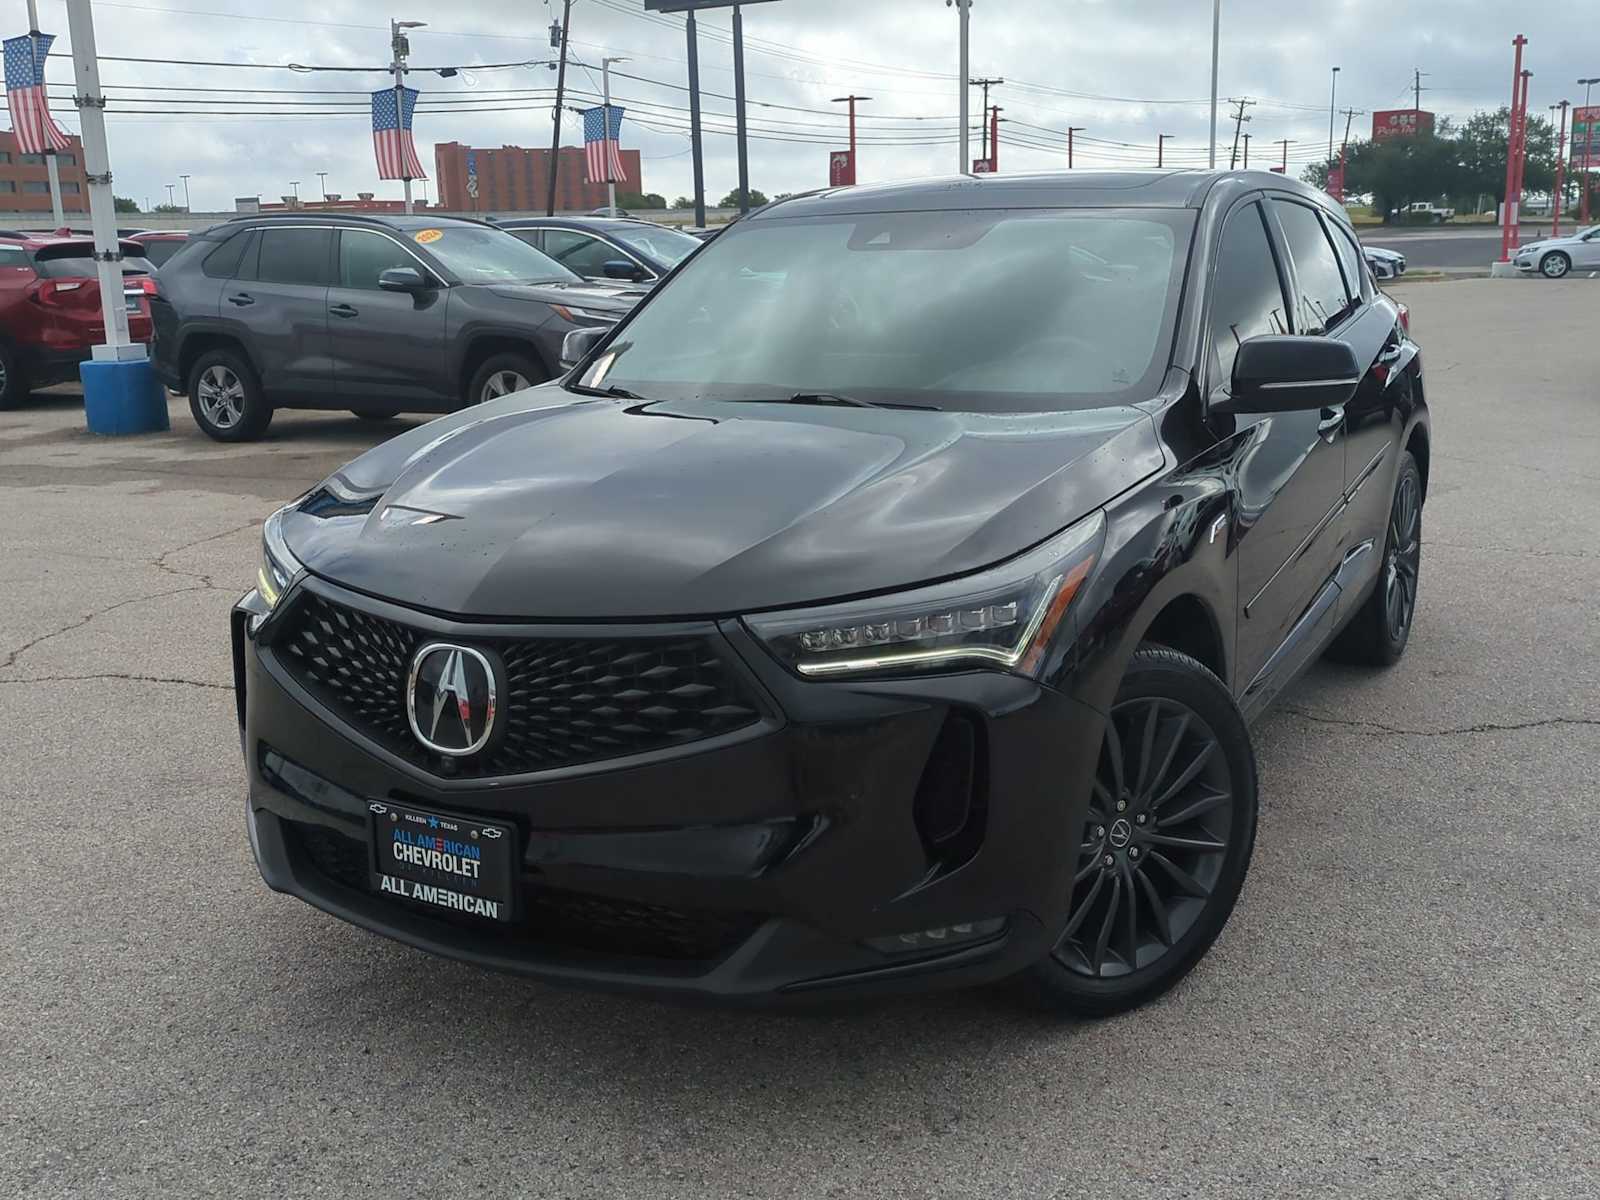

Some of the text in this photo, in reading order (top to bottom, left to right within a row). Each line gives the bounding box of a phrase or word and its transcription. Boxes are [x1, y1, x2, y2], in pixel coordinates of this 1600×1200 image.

[440, 821, 458, 831] TEXAS
[393, 842, 480, 878] CHEVROLET
[394, 830, 480, 859] ALL AMERICAN
[380, 875, 410, 897] ALL
[412, 883, 498, 919] AMERICAN
